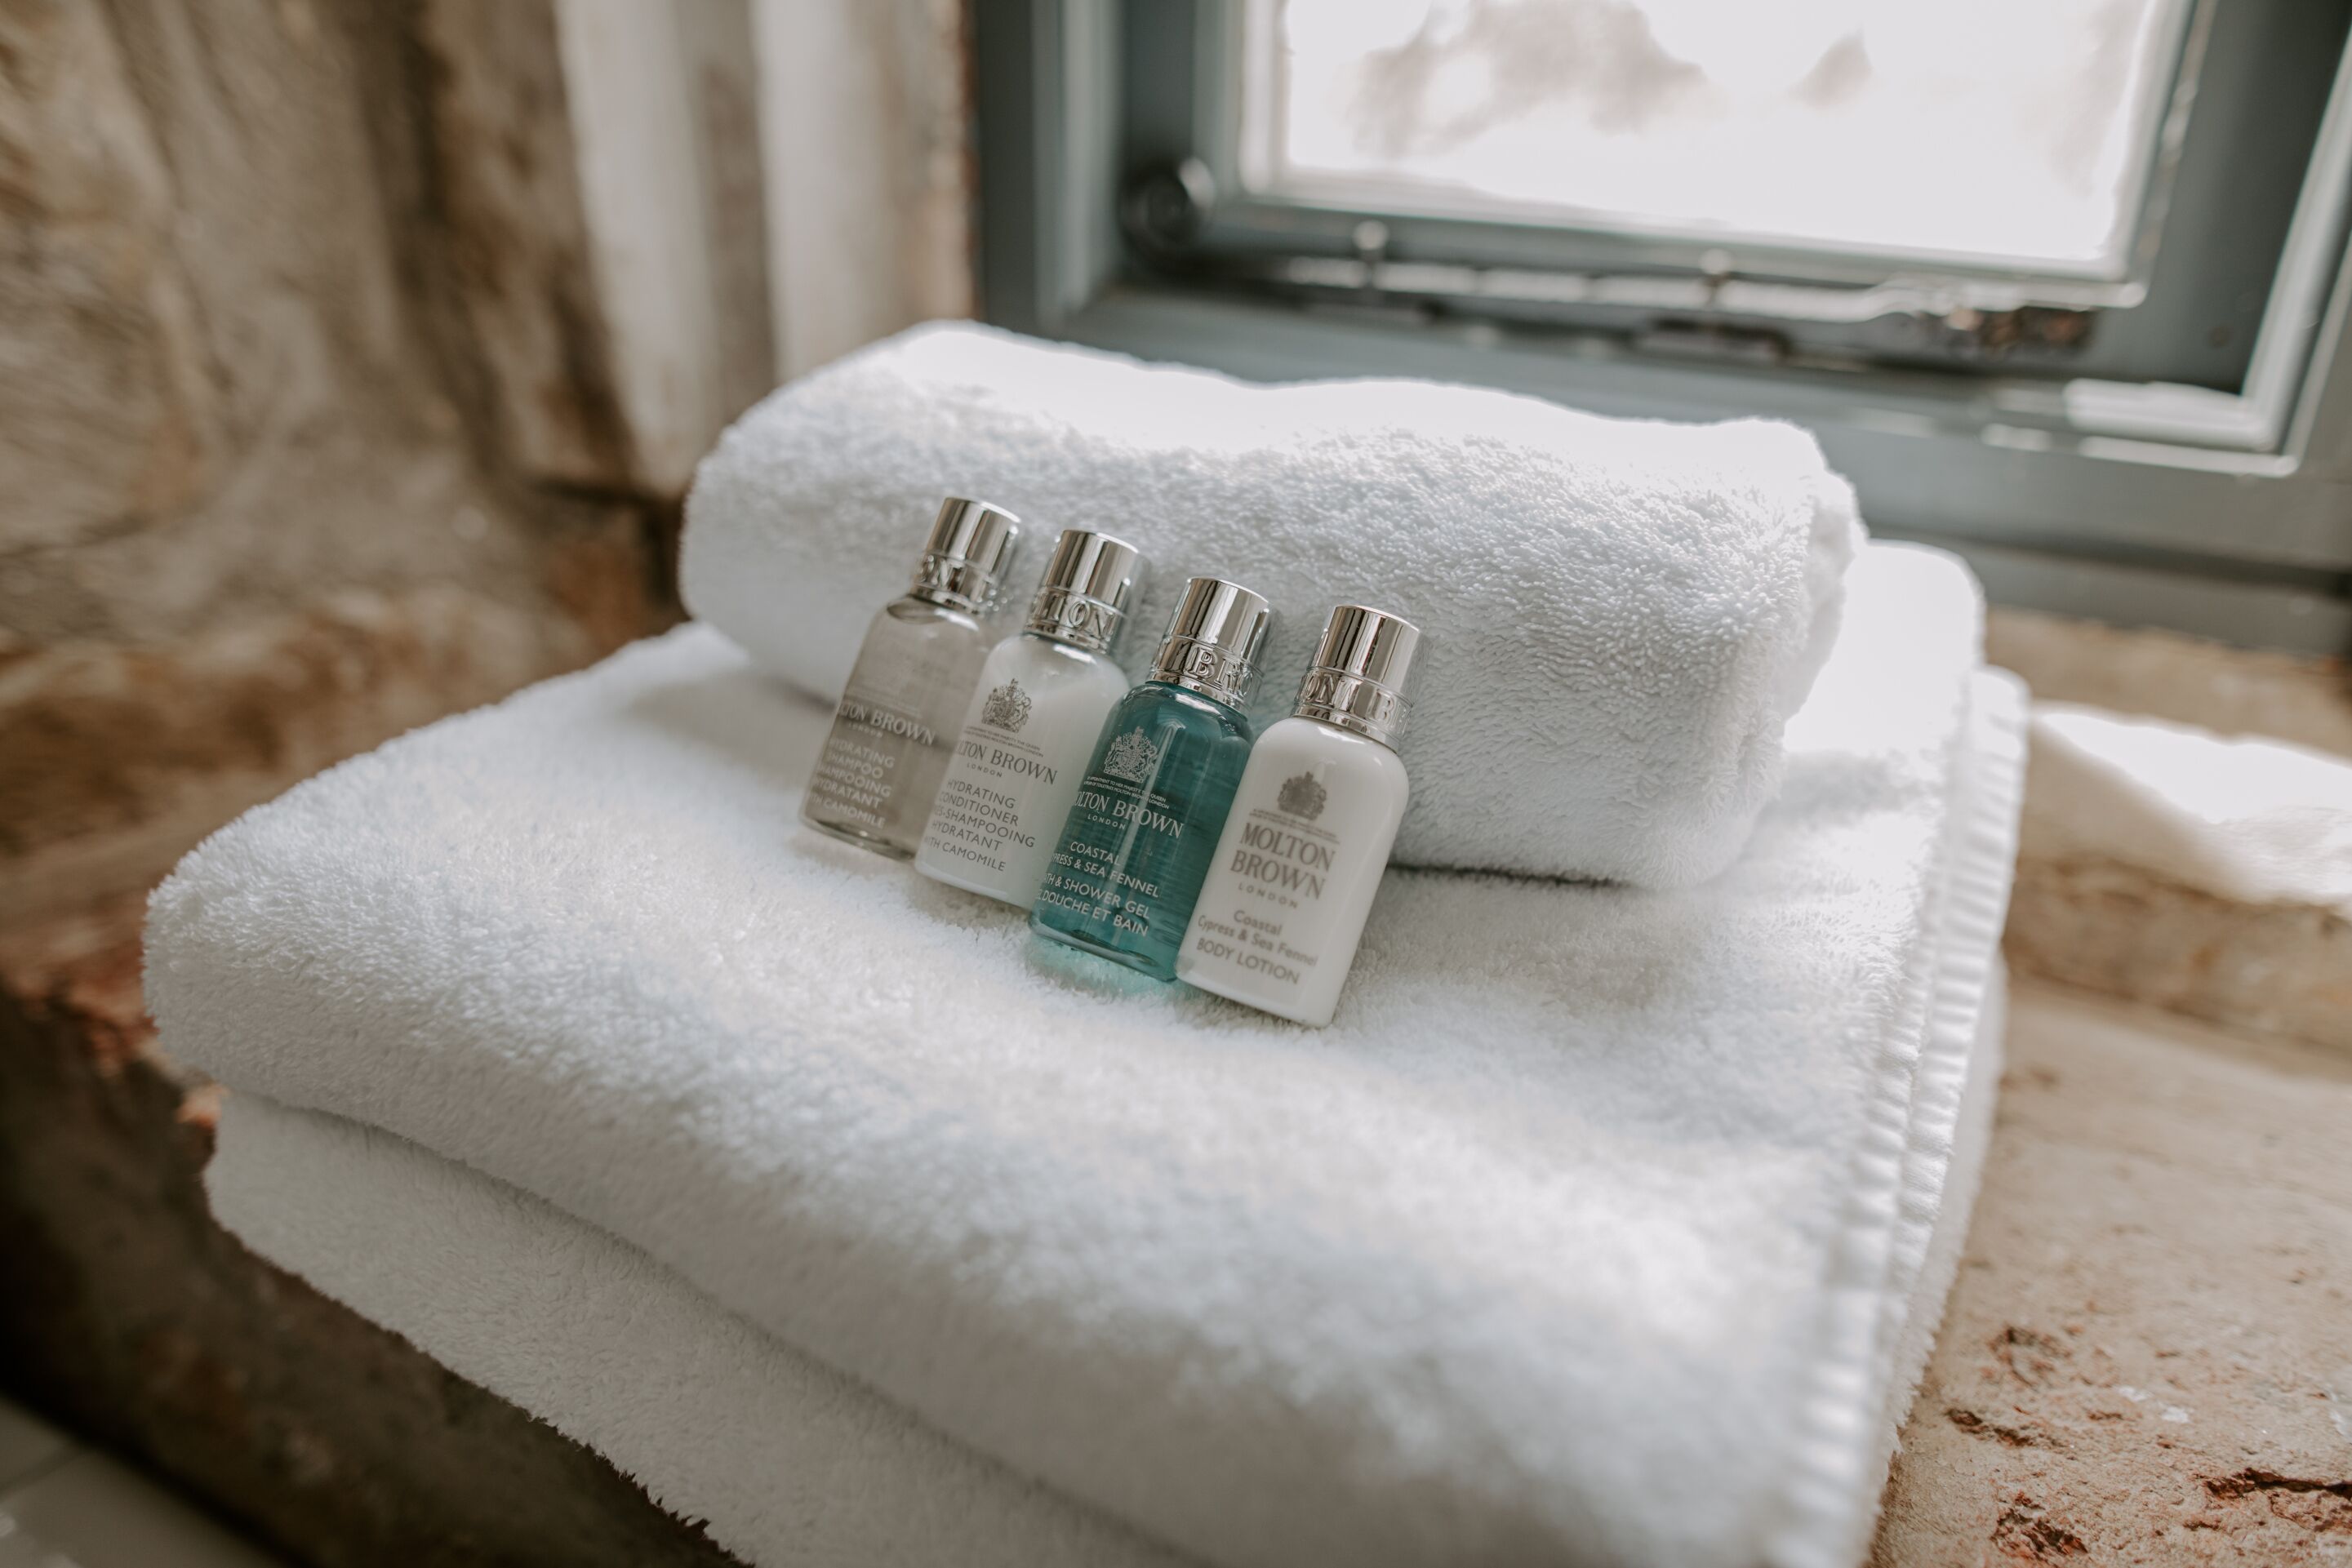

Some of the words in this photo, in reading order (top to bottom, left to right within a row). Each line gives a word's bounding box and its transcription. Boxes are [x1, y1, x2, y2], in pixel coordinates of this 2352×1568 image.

[1185, 644, 1252, 697] BRO
[870, 708, 935, 746] BROWN
[967, 762, 1003, 778] LONDON
[990, 748, 1058, 785] BROWN
[940, 790, 1020, 827] CONDITIONER
[947, 778, 1017, 810] HYDRATING
[1149, 798, 1170, 810] LONDON
[823, 797, 886, 829] CAMOMILE
[1087, 813, 1127, 831] LONDON
[1112, 799, 1185, 839] BROWN
[931, 819, 1004, 851] HYDRATANT
[1239, 822, 1336, 872] MOLTON
[942, 842, 1007, 872] CAMOMILE
[1070, 842, 1121, 866] COASTAL
[1074, 859, 1082, 869] &
[1083, 861, 1105, 878] SEA
[1109, 869, 1159, 899] FENNEL
[1229, 850, 1326, 900] BROWN
[1042, 890, 1091, 915] DOUCHE
[1092, 906, 1111, 922] ET
[1113, 914, 1149, 937] BAIN
[1055, 876, 1062, 887] &
[1063, 877, 1121, 908] SHOWER
[1125, 900, 1150, 920] GEL
[1238, 882, 1299, 909] LONDON
[1198, 914, 1234, 938] Cypress
[1238, 929, 1247, 942] &
[1251, 932, 1274, 952] Sea
[1278, 942, 1319, 968] Fennel
[1233, 910, 1283, 936] Coastal
[1196, 938, 1235, 960] BODY
[1237, 950, 1300, 985] LOTION
